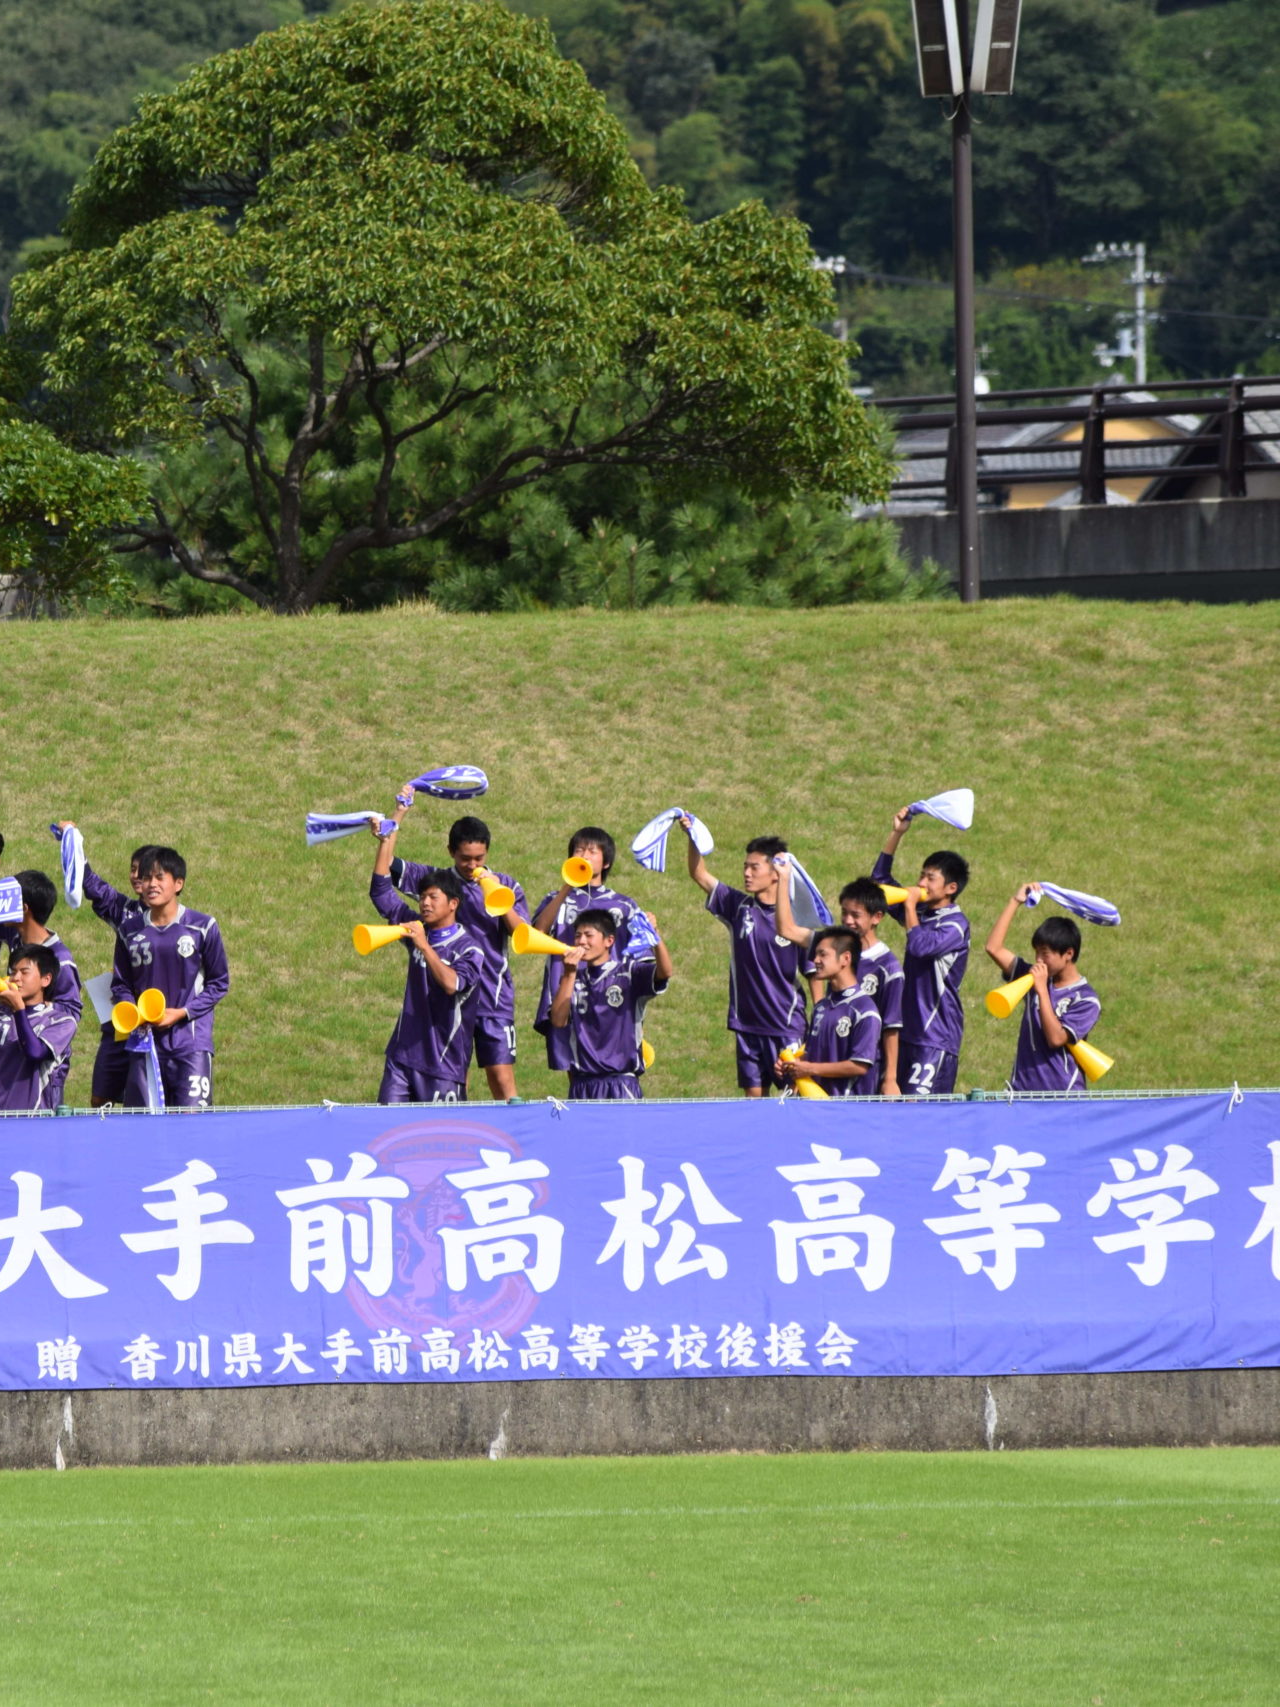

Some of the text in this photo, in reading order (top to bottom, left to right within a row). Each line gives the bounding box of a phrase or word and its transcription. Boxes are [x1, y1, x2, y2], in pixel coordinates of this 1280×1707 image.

[129, 942, 153, 968] 33
[188, 1075, 210, 1098] 39
[908, 1062, 936, 1088] 22
[36, 1320, 858, 1382] 贈 香川県大手前高松高等学校後援会
